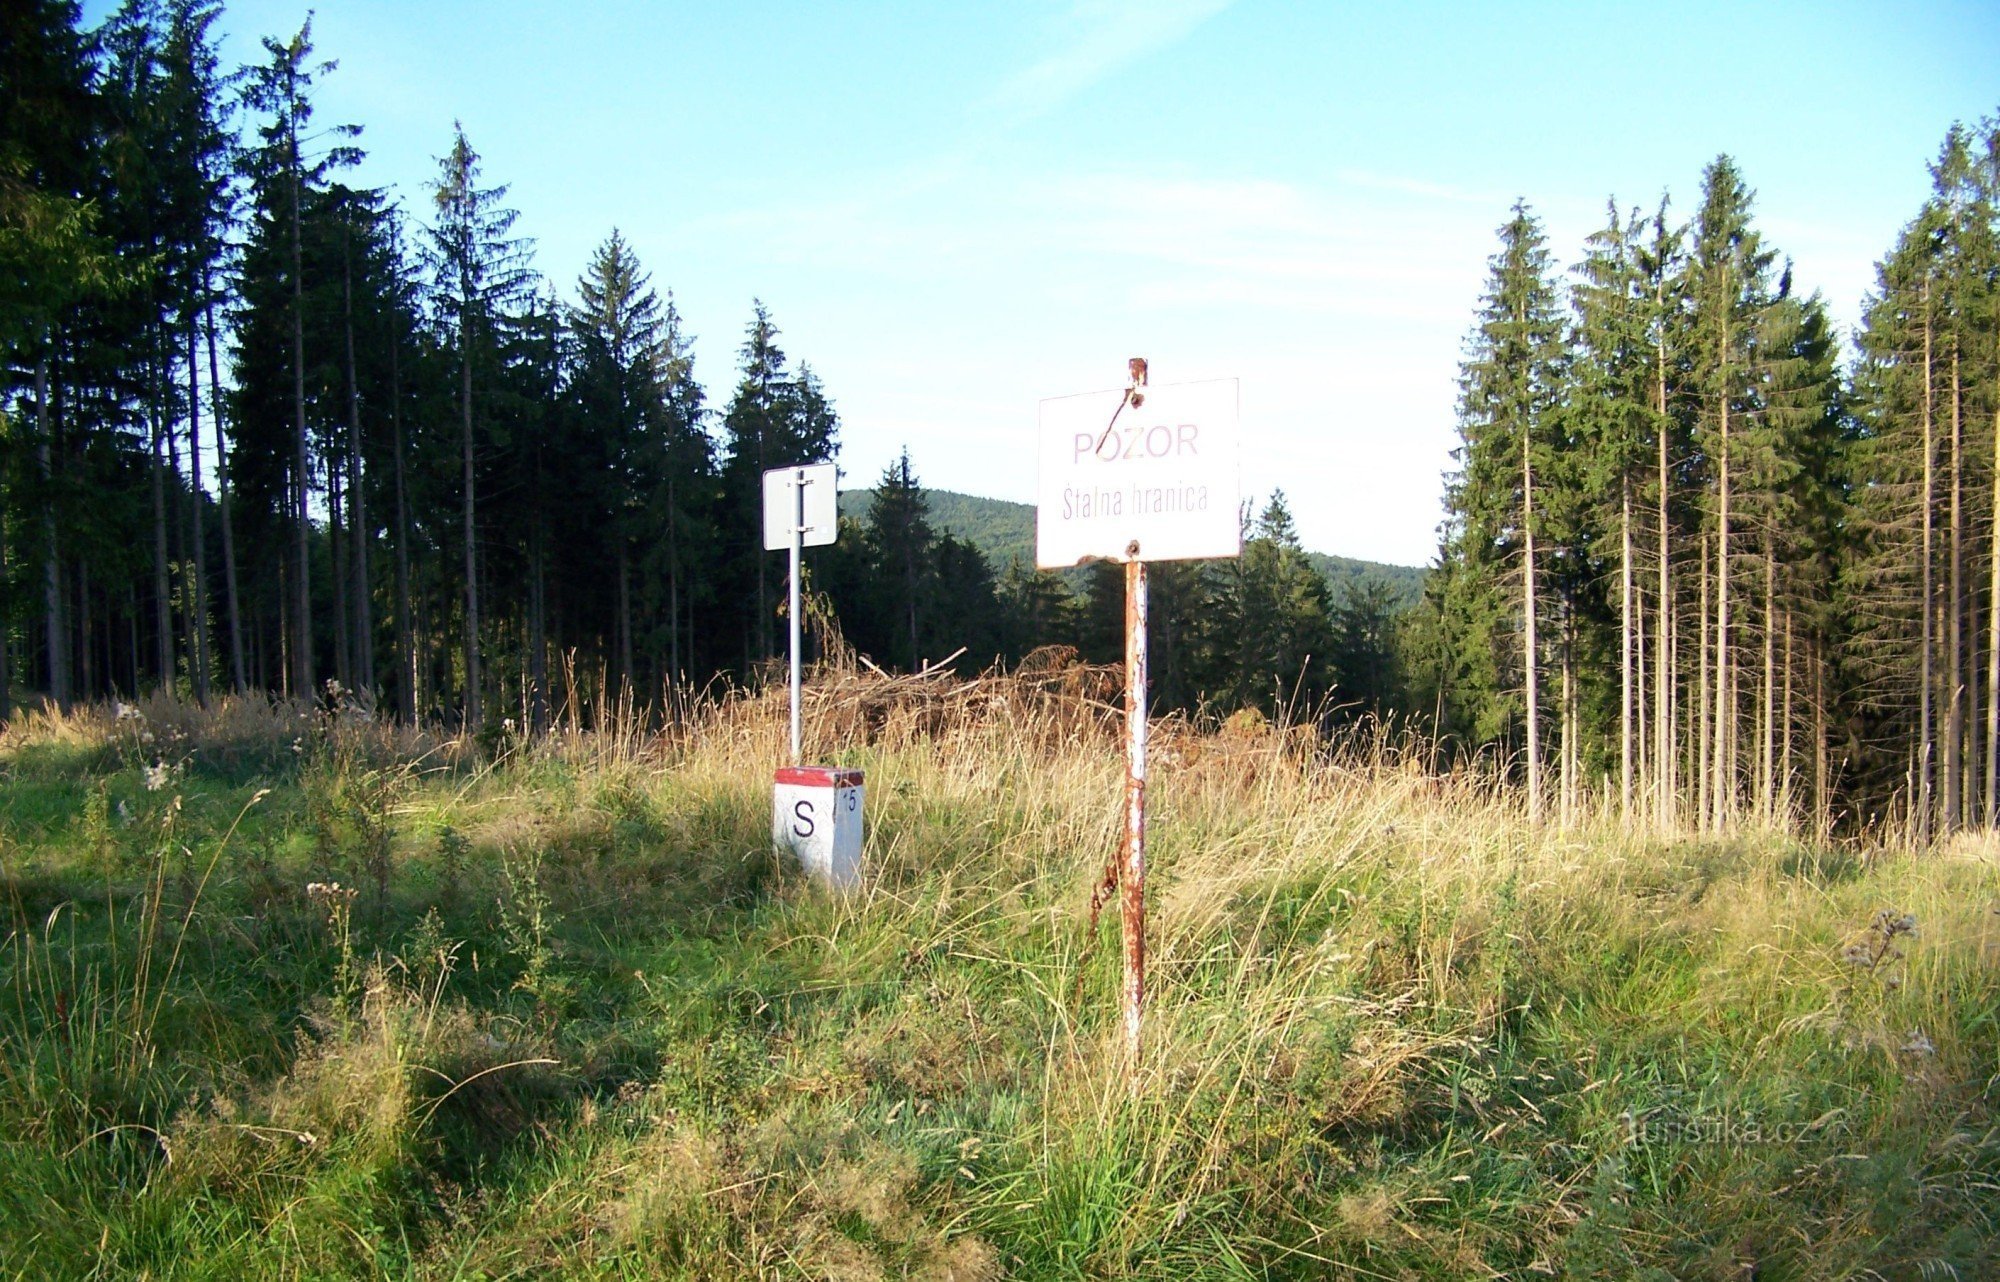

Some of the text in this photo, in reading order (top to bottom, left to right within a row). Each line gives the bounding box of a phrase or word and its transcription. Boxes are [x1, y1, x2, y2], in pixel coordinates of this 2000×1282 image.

[1073, 424, 1198, 464] POZOR
[1132, 480, 1208, 514] hranica
[793, 800, 814, 837] S
